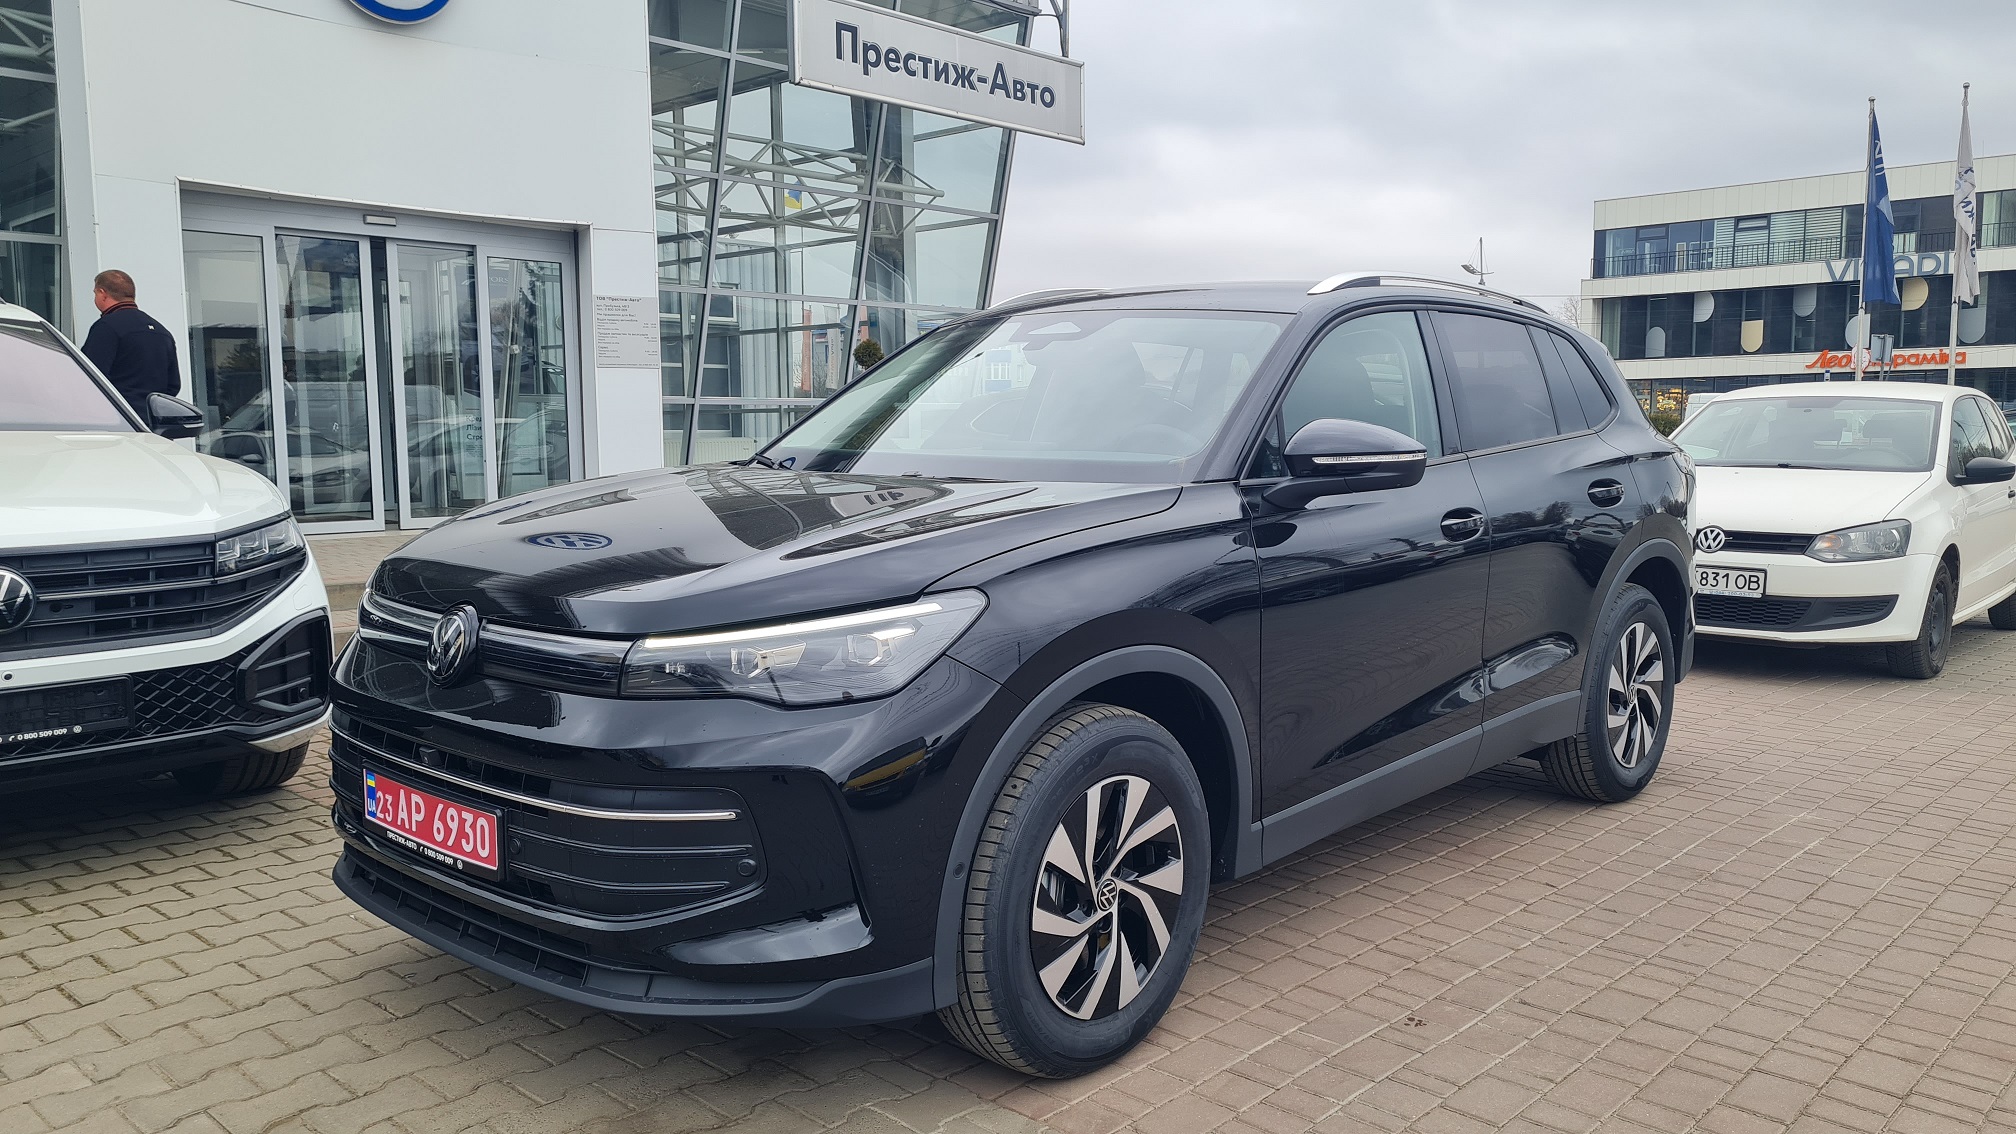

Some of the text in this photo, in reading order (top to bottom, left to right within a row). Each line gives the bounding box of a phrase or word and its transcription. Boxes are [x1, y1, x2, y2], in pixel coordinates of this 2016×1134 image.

[835, 20, 1056, 108] Престиж-Авто
[1806, 349, 1851, 369] Лео
[23, 732, 38, 740] 800
[38, 730, 53, 738] 509
[53, 728, 68, 736] 009
[367, 789, 490, 858] UA 23 AP 6930
